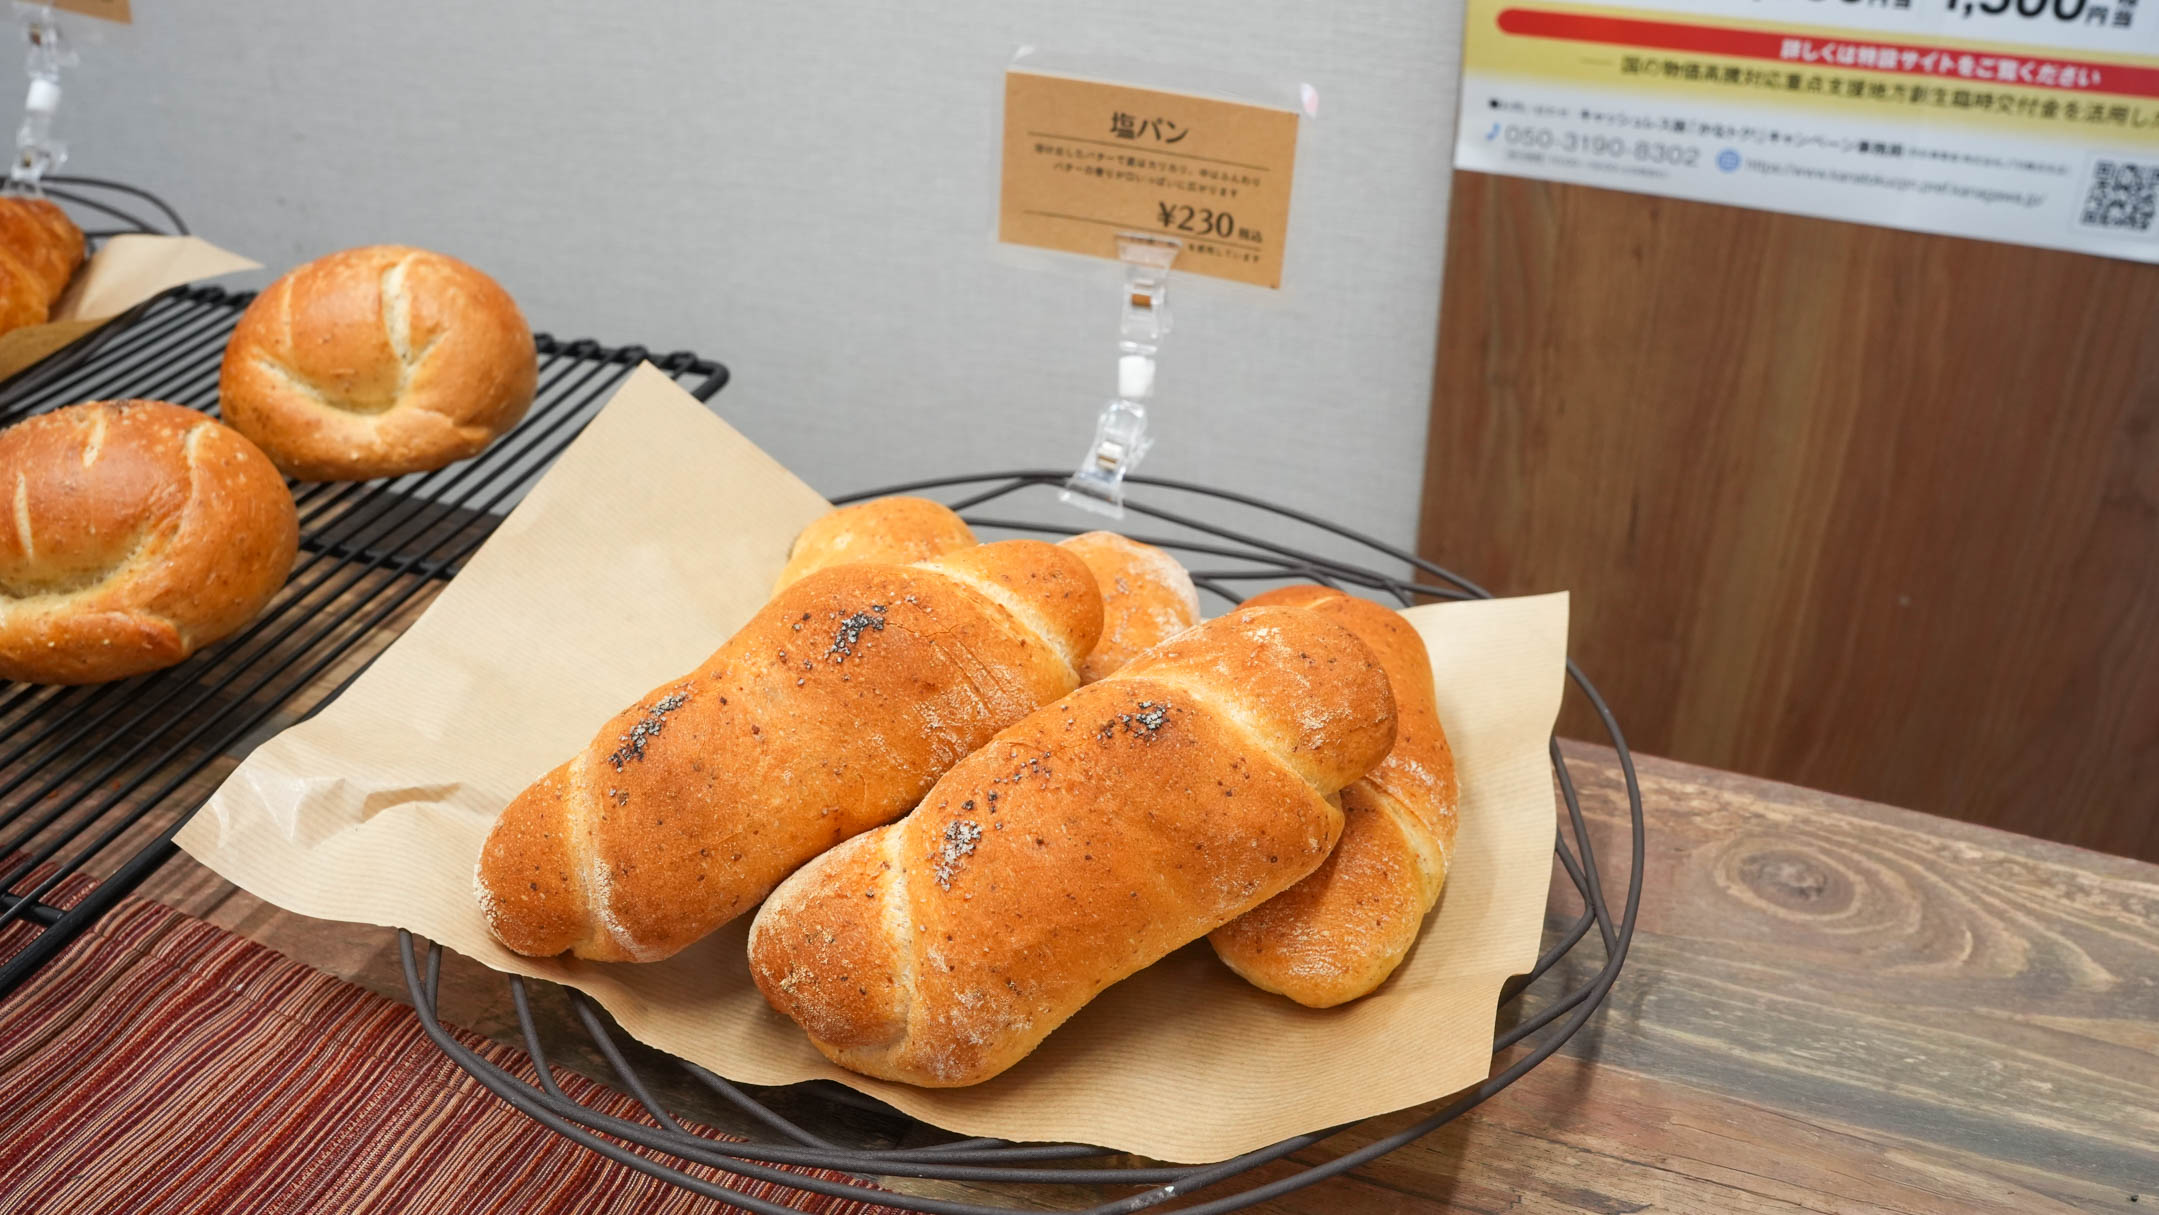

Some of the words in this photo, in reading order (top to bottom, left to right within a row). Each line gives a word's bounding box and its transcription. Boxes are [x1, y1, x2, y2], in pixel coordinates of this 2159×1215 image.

[1780, 38, 2101, 88] 詳しくは特設サイトをご覧ください
[1109, 110, 1190, 145] 塩パン
[1157, 200, 1235, 239] ¥230
